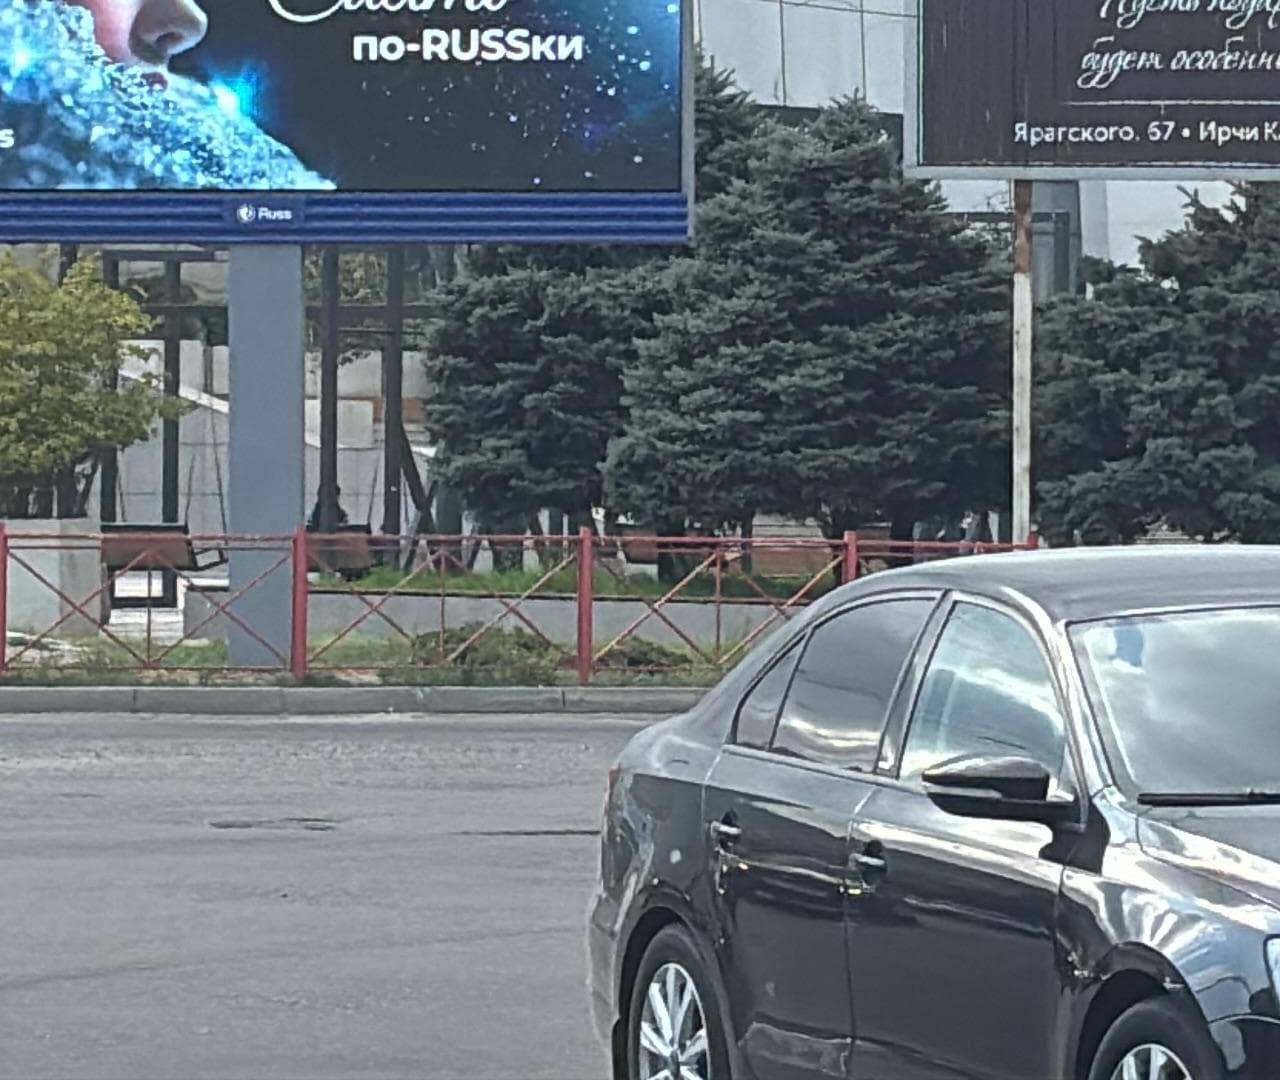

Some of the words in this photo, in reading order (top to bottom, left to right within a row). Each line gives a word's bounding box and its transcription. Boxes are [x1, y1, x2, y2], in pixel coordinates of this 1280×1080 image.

[353, 28, 584, 62] по-RUSSки
[1076, 35, 1164, 89] будет
[1148, 121, 1176, 141] 67
[1198, 121, 1260, 147] Ирчи
